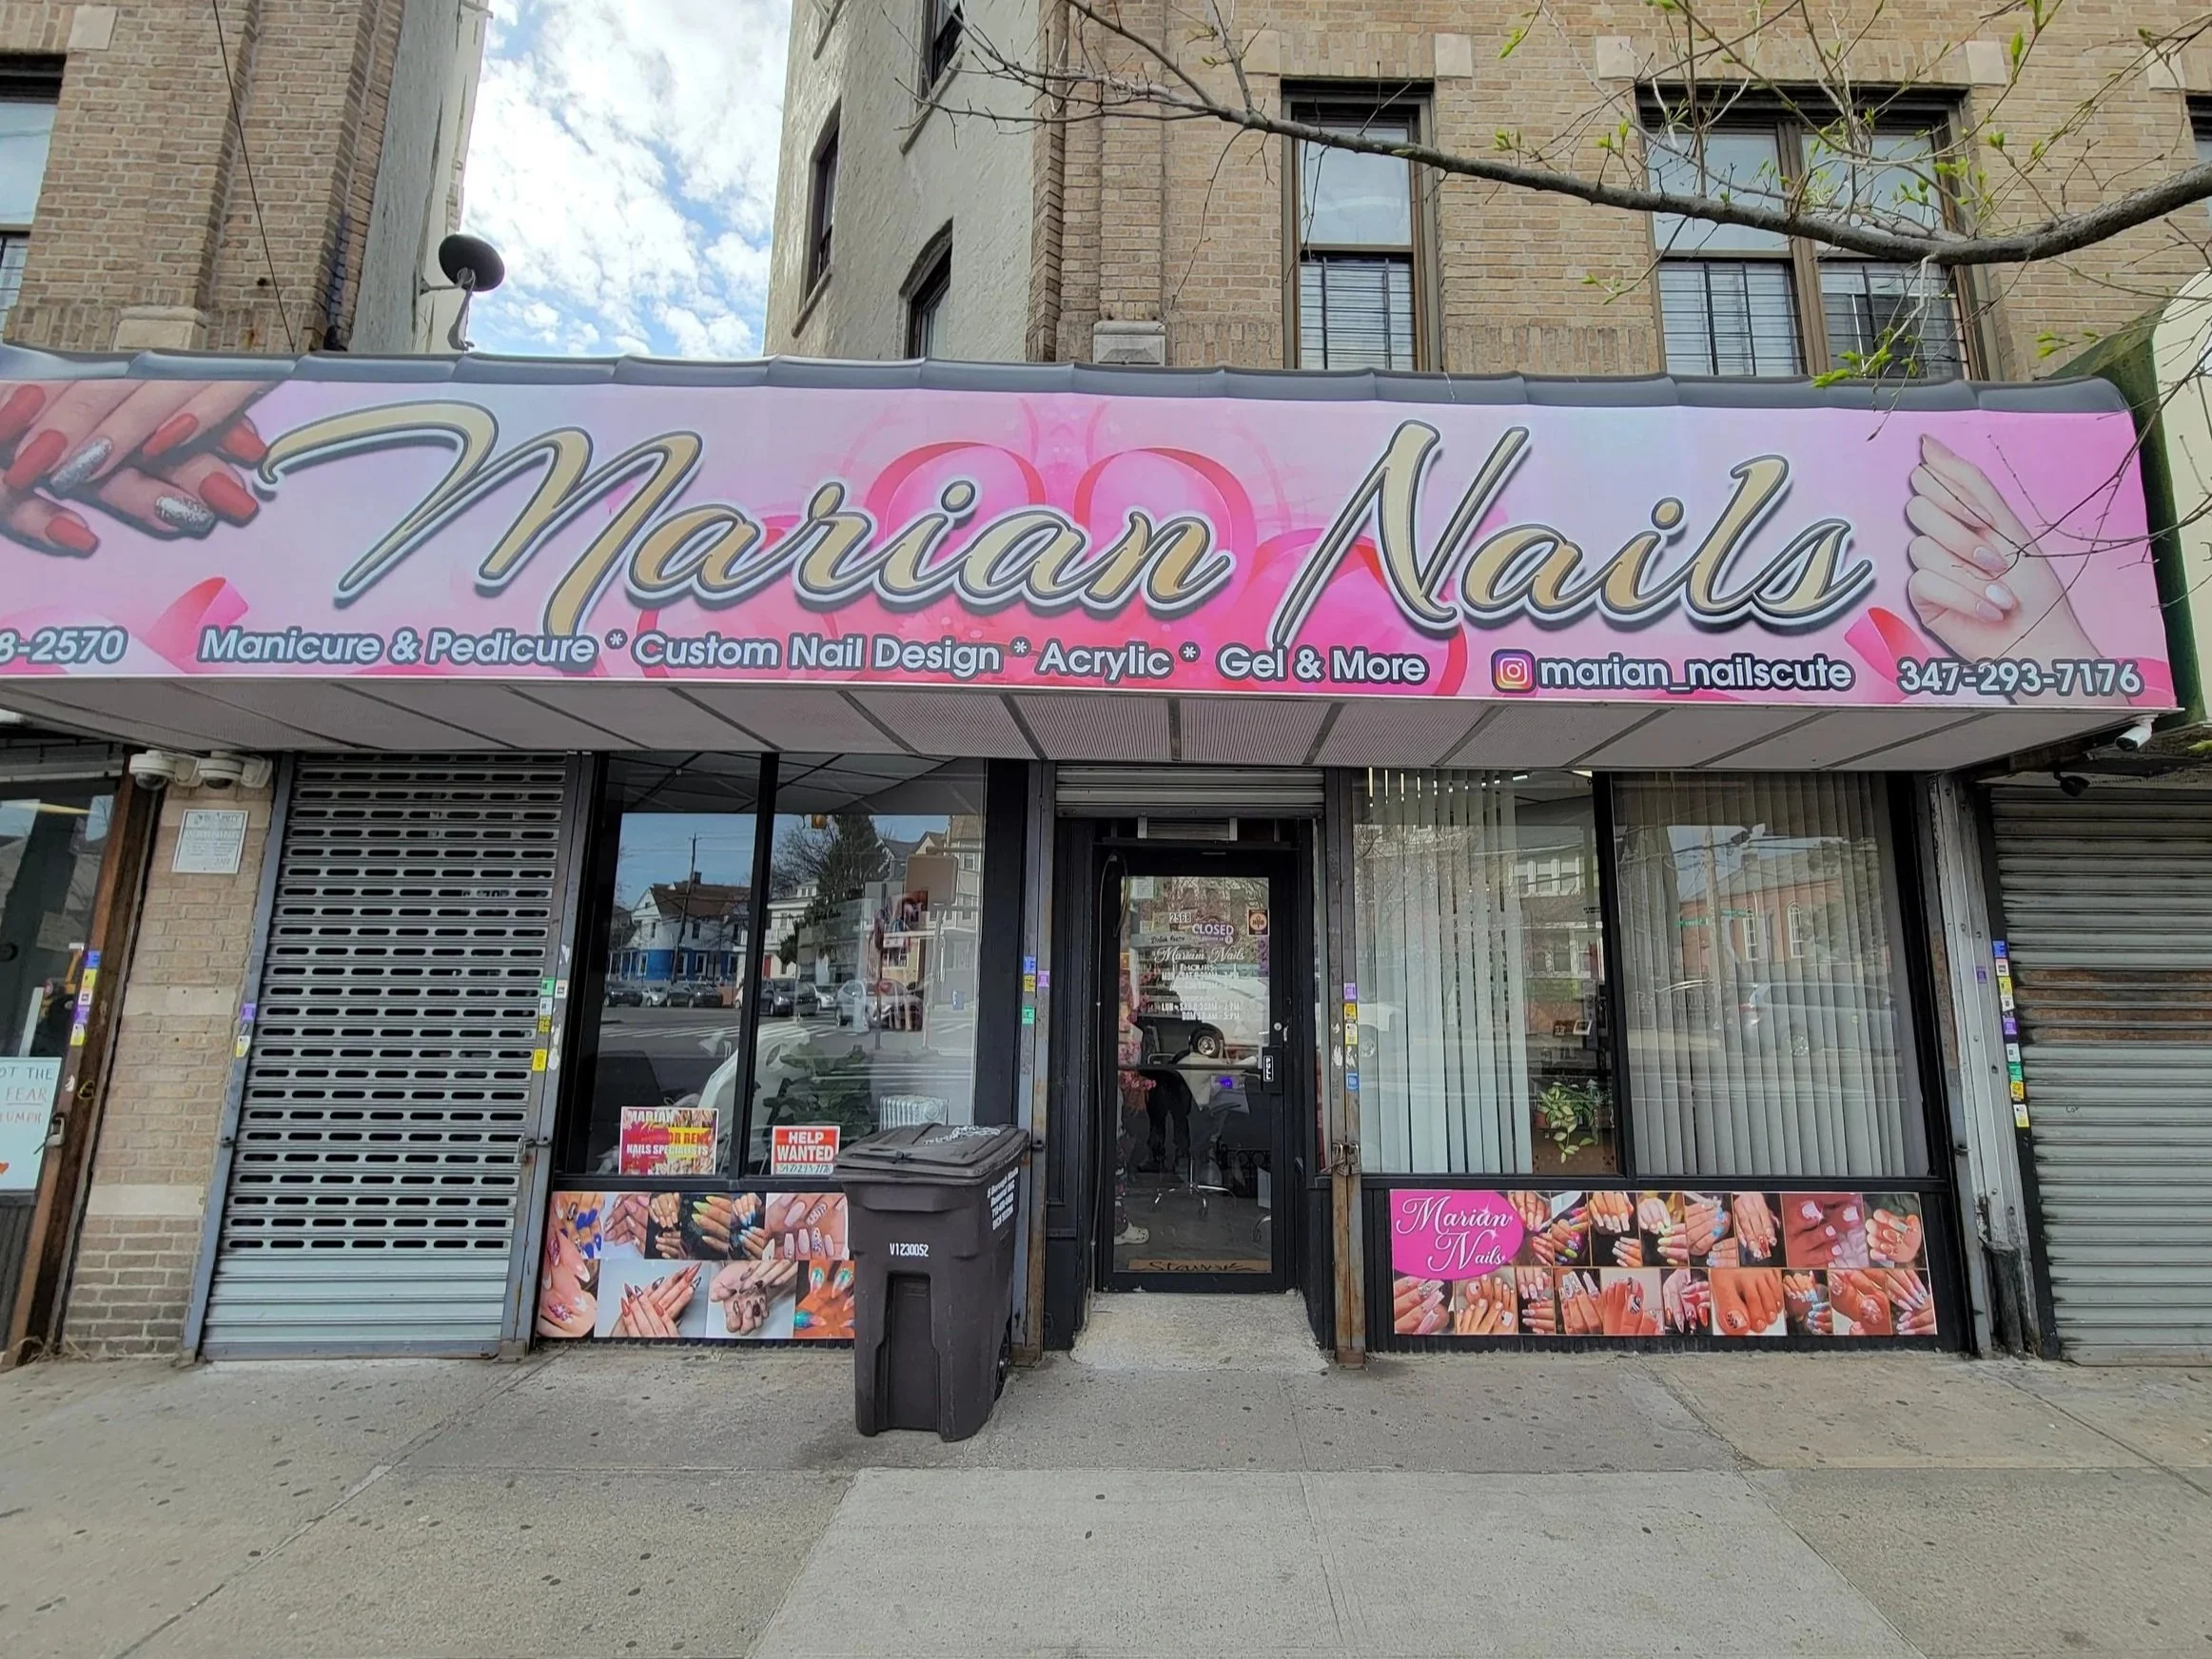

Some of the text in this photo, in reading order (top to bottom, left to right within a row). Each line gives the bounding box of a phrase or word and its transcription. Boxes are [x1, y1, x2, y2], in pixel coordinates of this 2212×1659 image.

[260, 400, 1872, 648] Marian Nails
[0, 629, 126, 662] 8-2570
[201, 629, 1426, 681] Manicure & Pedicure Custom Nail Design Acrylic Gel & More
[1539, 654, 1853, 692] marian_nailscute
[1901, 660, 2141, 693] 347-293-7176
[1192, 924, 1235, 936] CLOSED
[1208, 945, 1245, 963] Nails
[626, 1144, 652, 1155] NAILS
[776, 1145, 834, 1161] WANTED
[788, 1131, 824, 1144] HELP
[1396, 1196, 1511, 1237] Marian
[889, 1242, 930, 1257] V1230052
[1427, 1229, 1505, 1272] Nails
